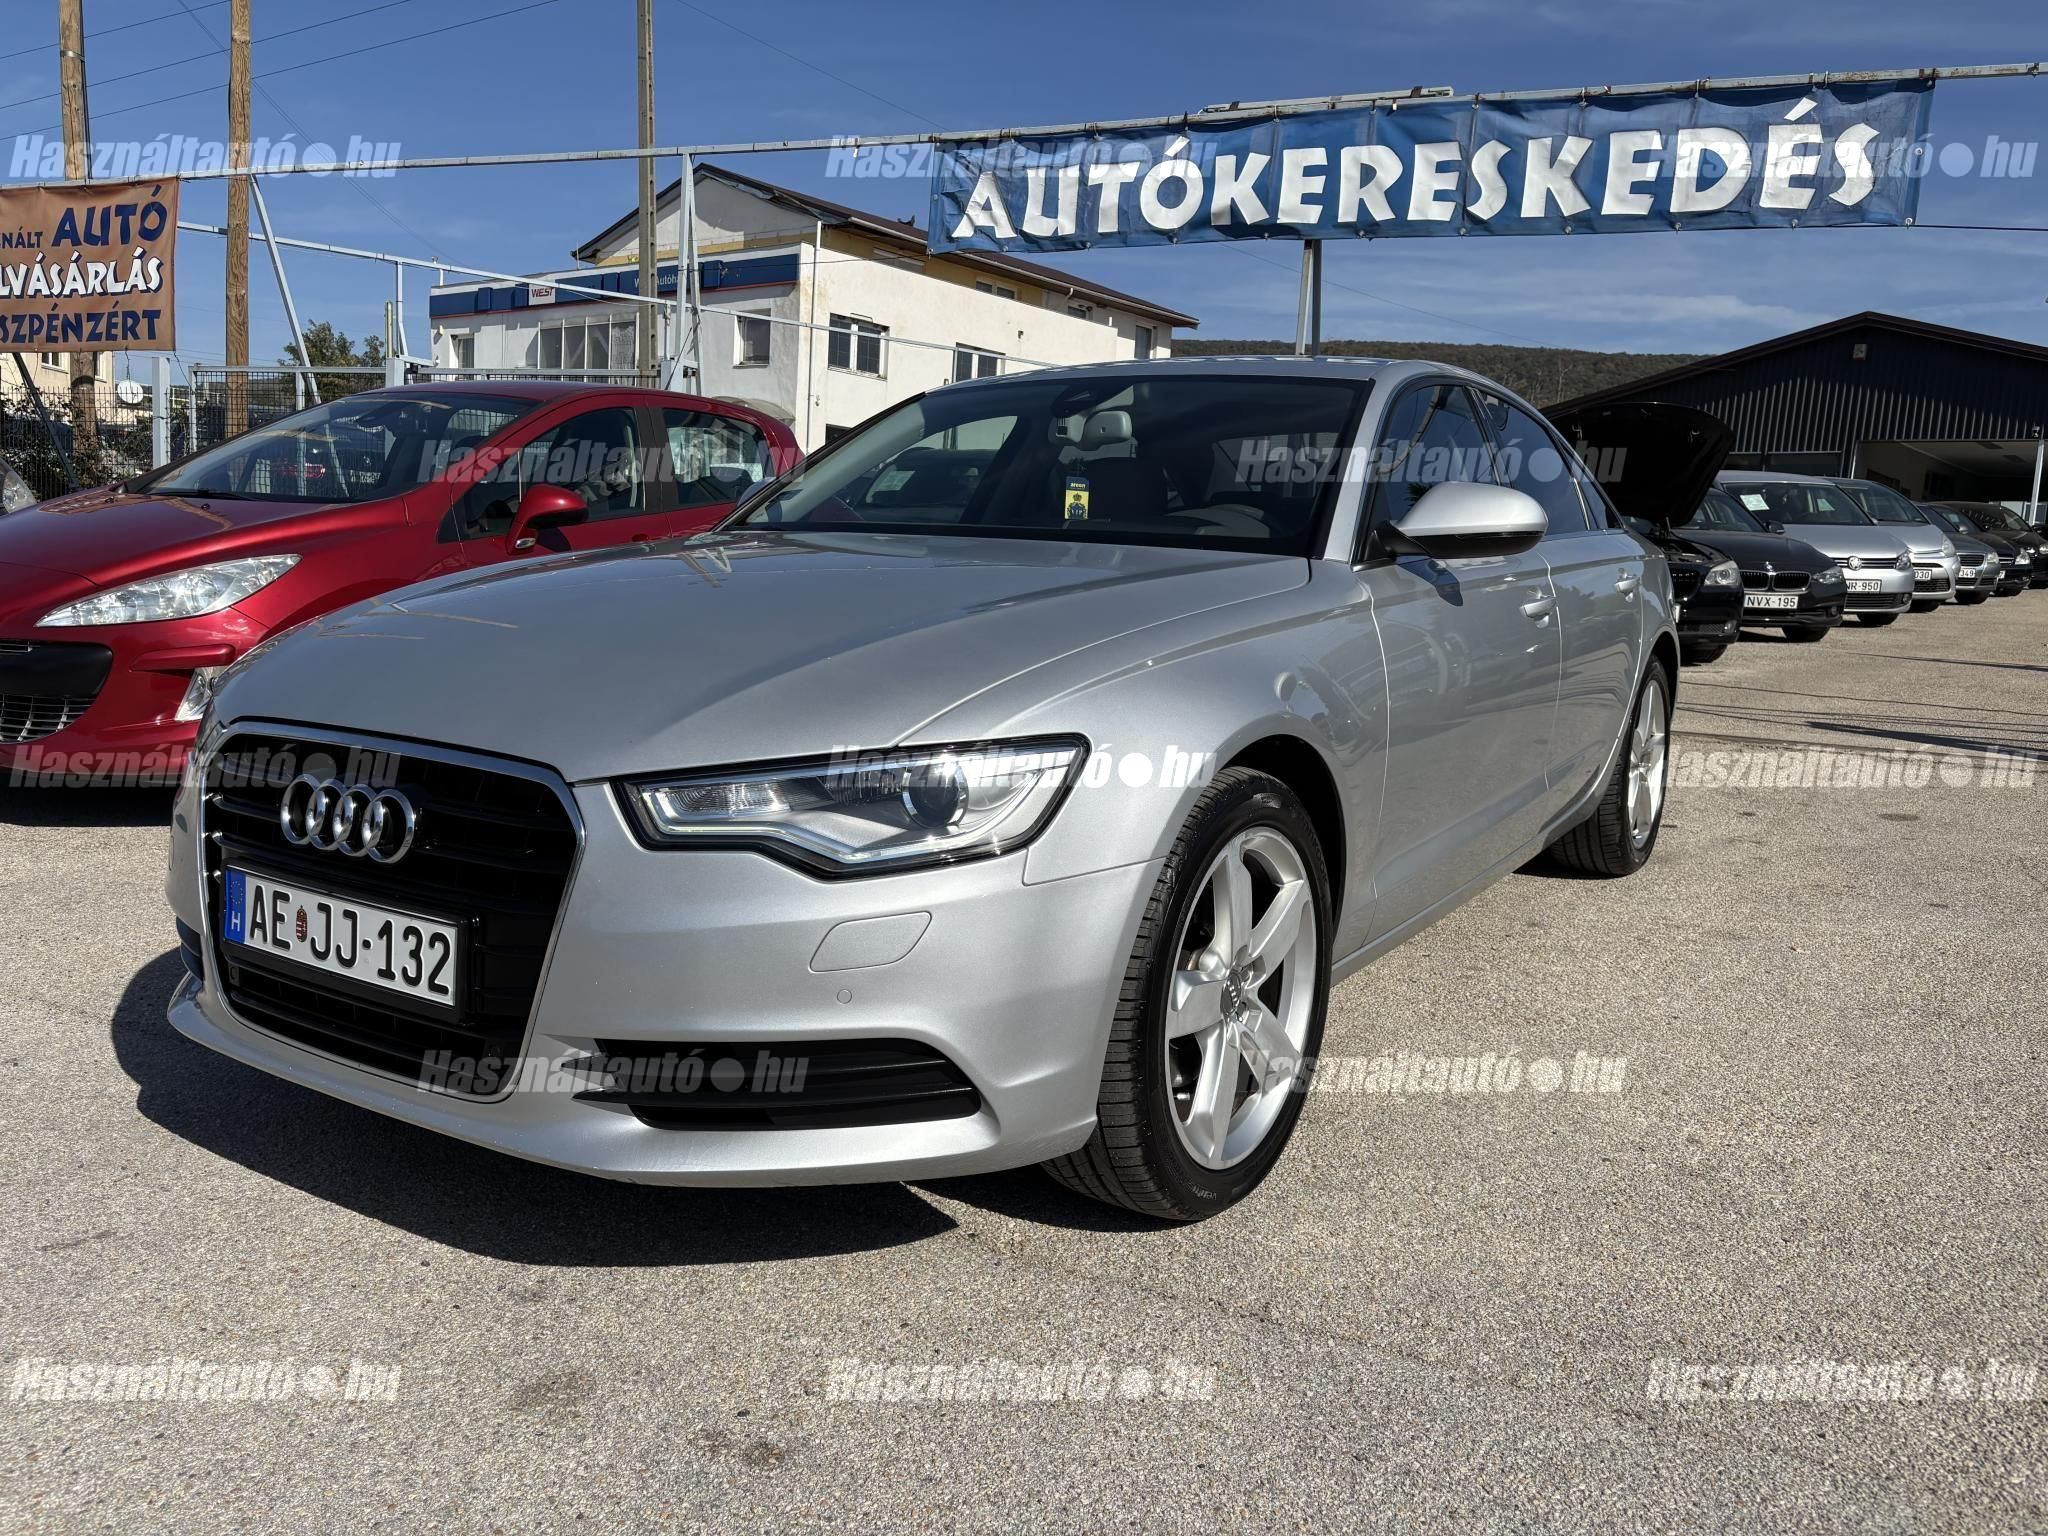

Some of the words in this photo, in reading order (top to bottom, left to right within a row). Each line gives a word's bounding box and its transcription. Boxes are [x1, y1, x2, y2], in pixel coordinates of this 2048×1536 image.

[951, 97, 1880, 239] AUTÓKERESKEDÉS
[0, 226, 43, 249] NÁLT
[52, 184, 168, 246] AUTÓ
[531, 286, 555, 298] WEST
[1747, 596, 1796, 608] NVX-195
[250, 884, 292, 951] AE
